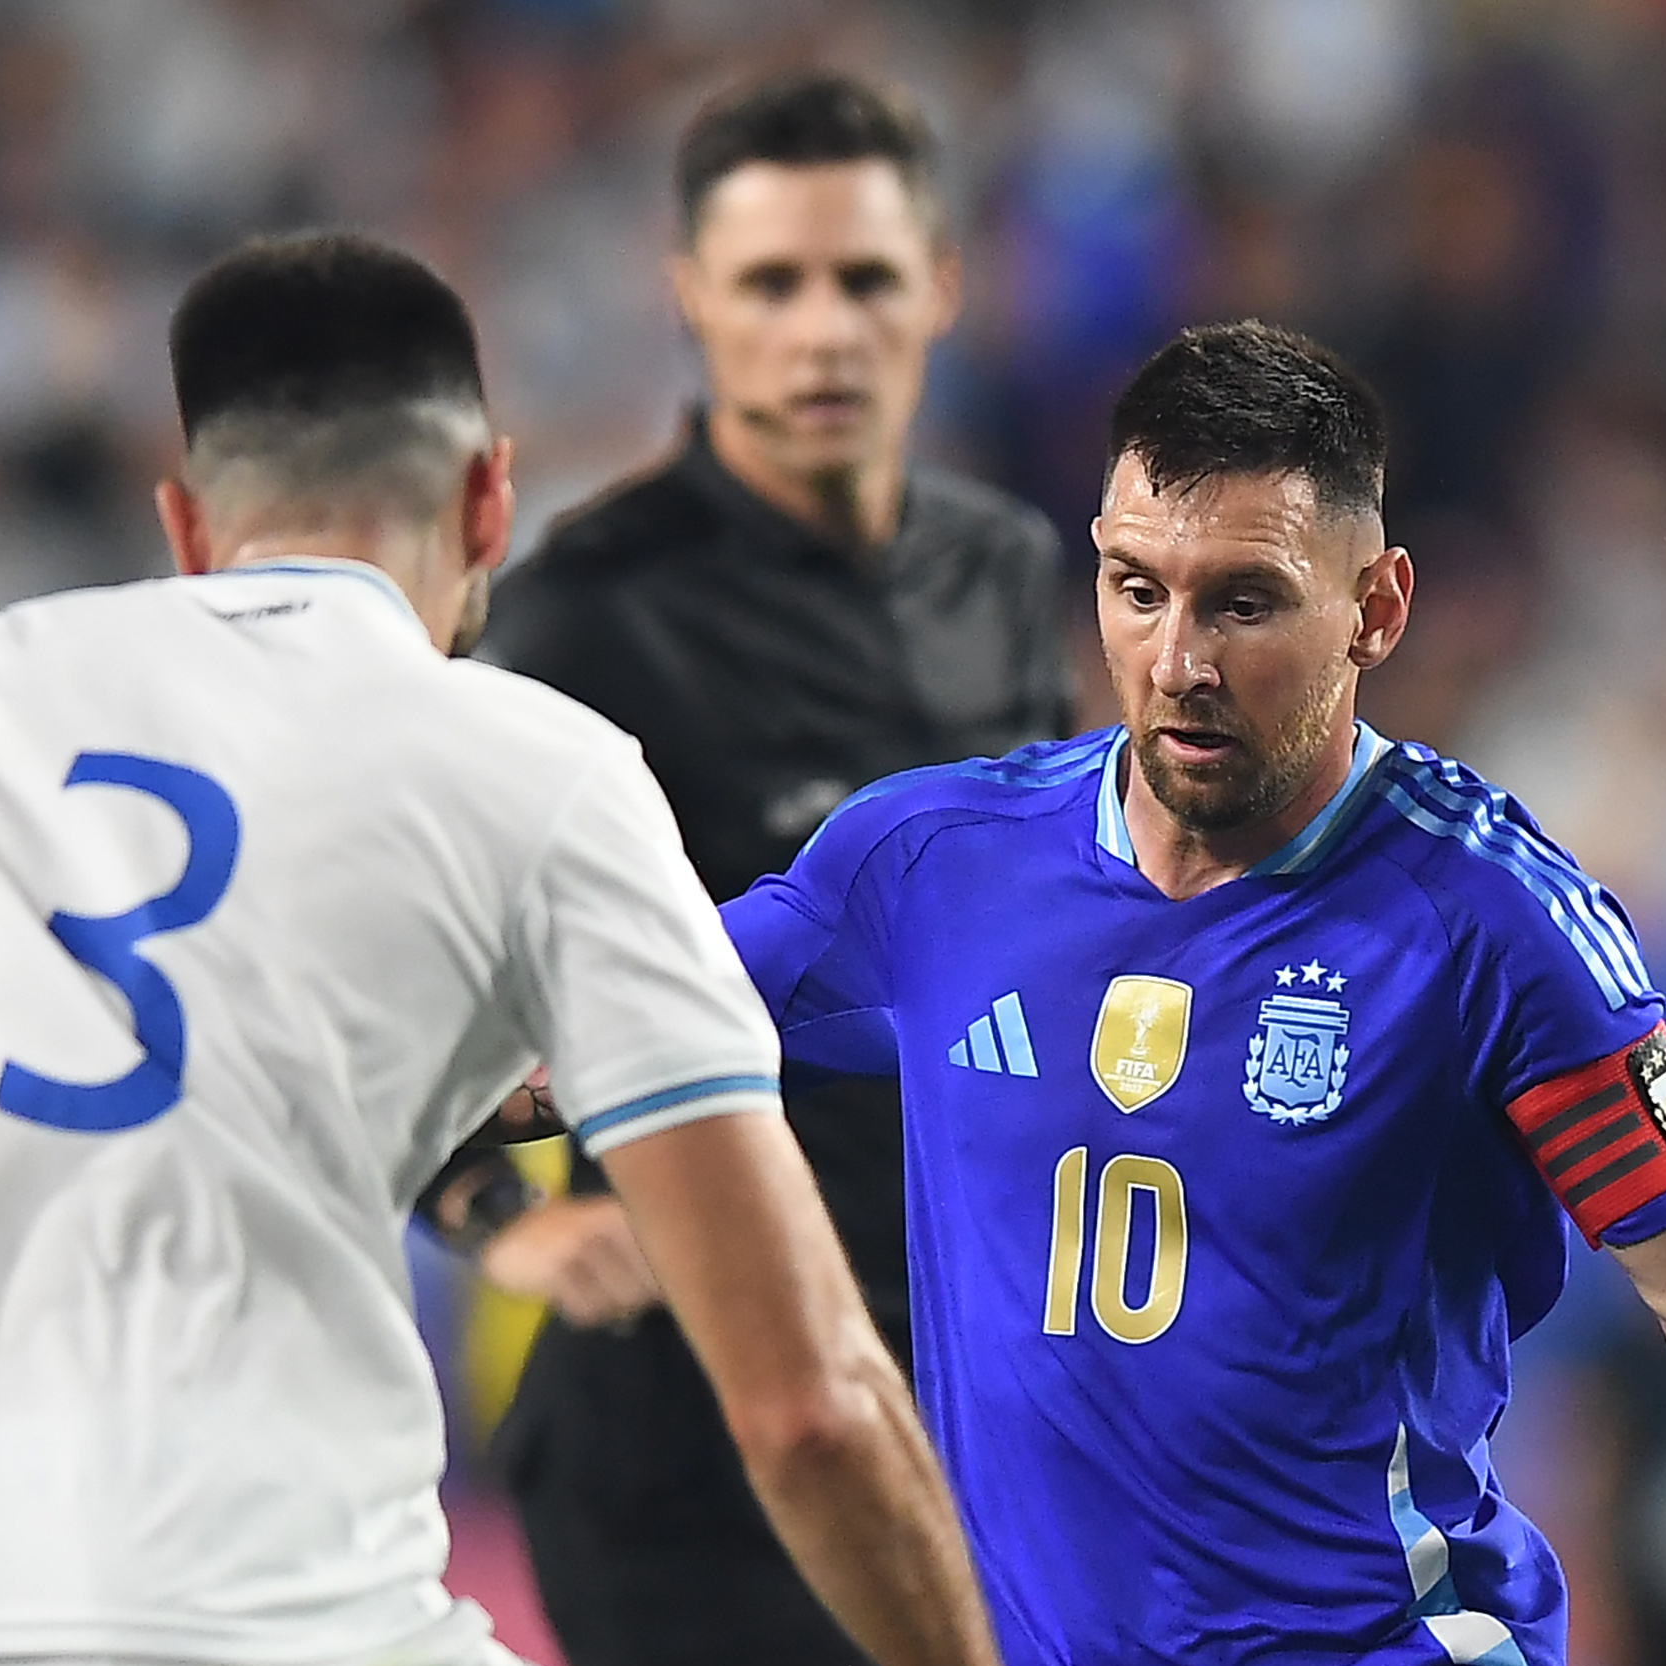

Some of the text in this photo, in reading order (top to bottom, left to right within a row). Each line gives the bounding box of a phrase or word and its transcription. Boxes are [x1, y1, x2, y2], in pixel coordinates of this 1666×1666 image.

[1115, 1058, 1155, 1081] FIFA
[1266, 1028, 1325, 1089] AFA
[1043, 1145, 1189, 1345] 10
